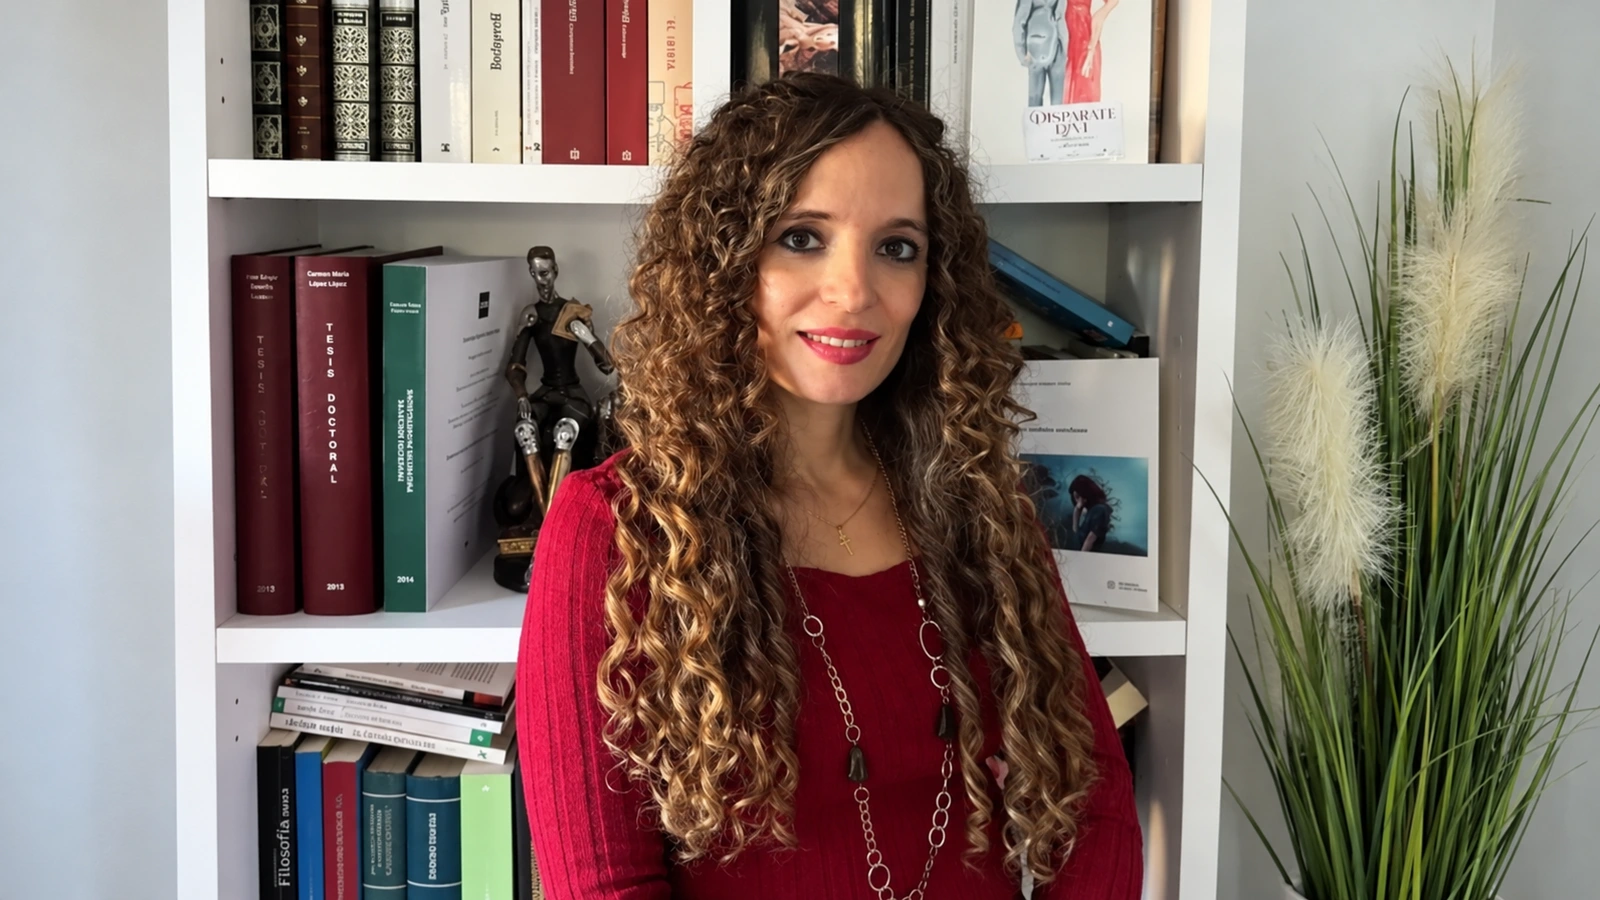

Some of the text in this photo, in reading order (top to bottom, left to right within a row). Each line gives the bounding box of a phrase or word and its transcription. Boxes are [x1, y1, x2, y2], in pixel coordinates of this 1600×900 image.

[1029, 108, 1116, 124] DISPARATE
[326, 322, 338, 484] TESIS DOCTORAL
[397, 575, 415, 584] 2014
[257, 585, 276, 593] 2013
[326, 583, 345, 591] 2013
